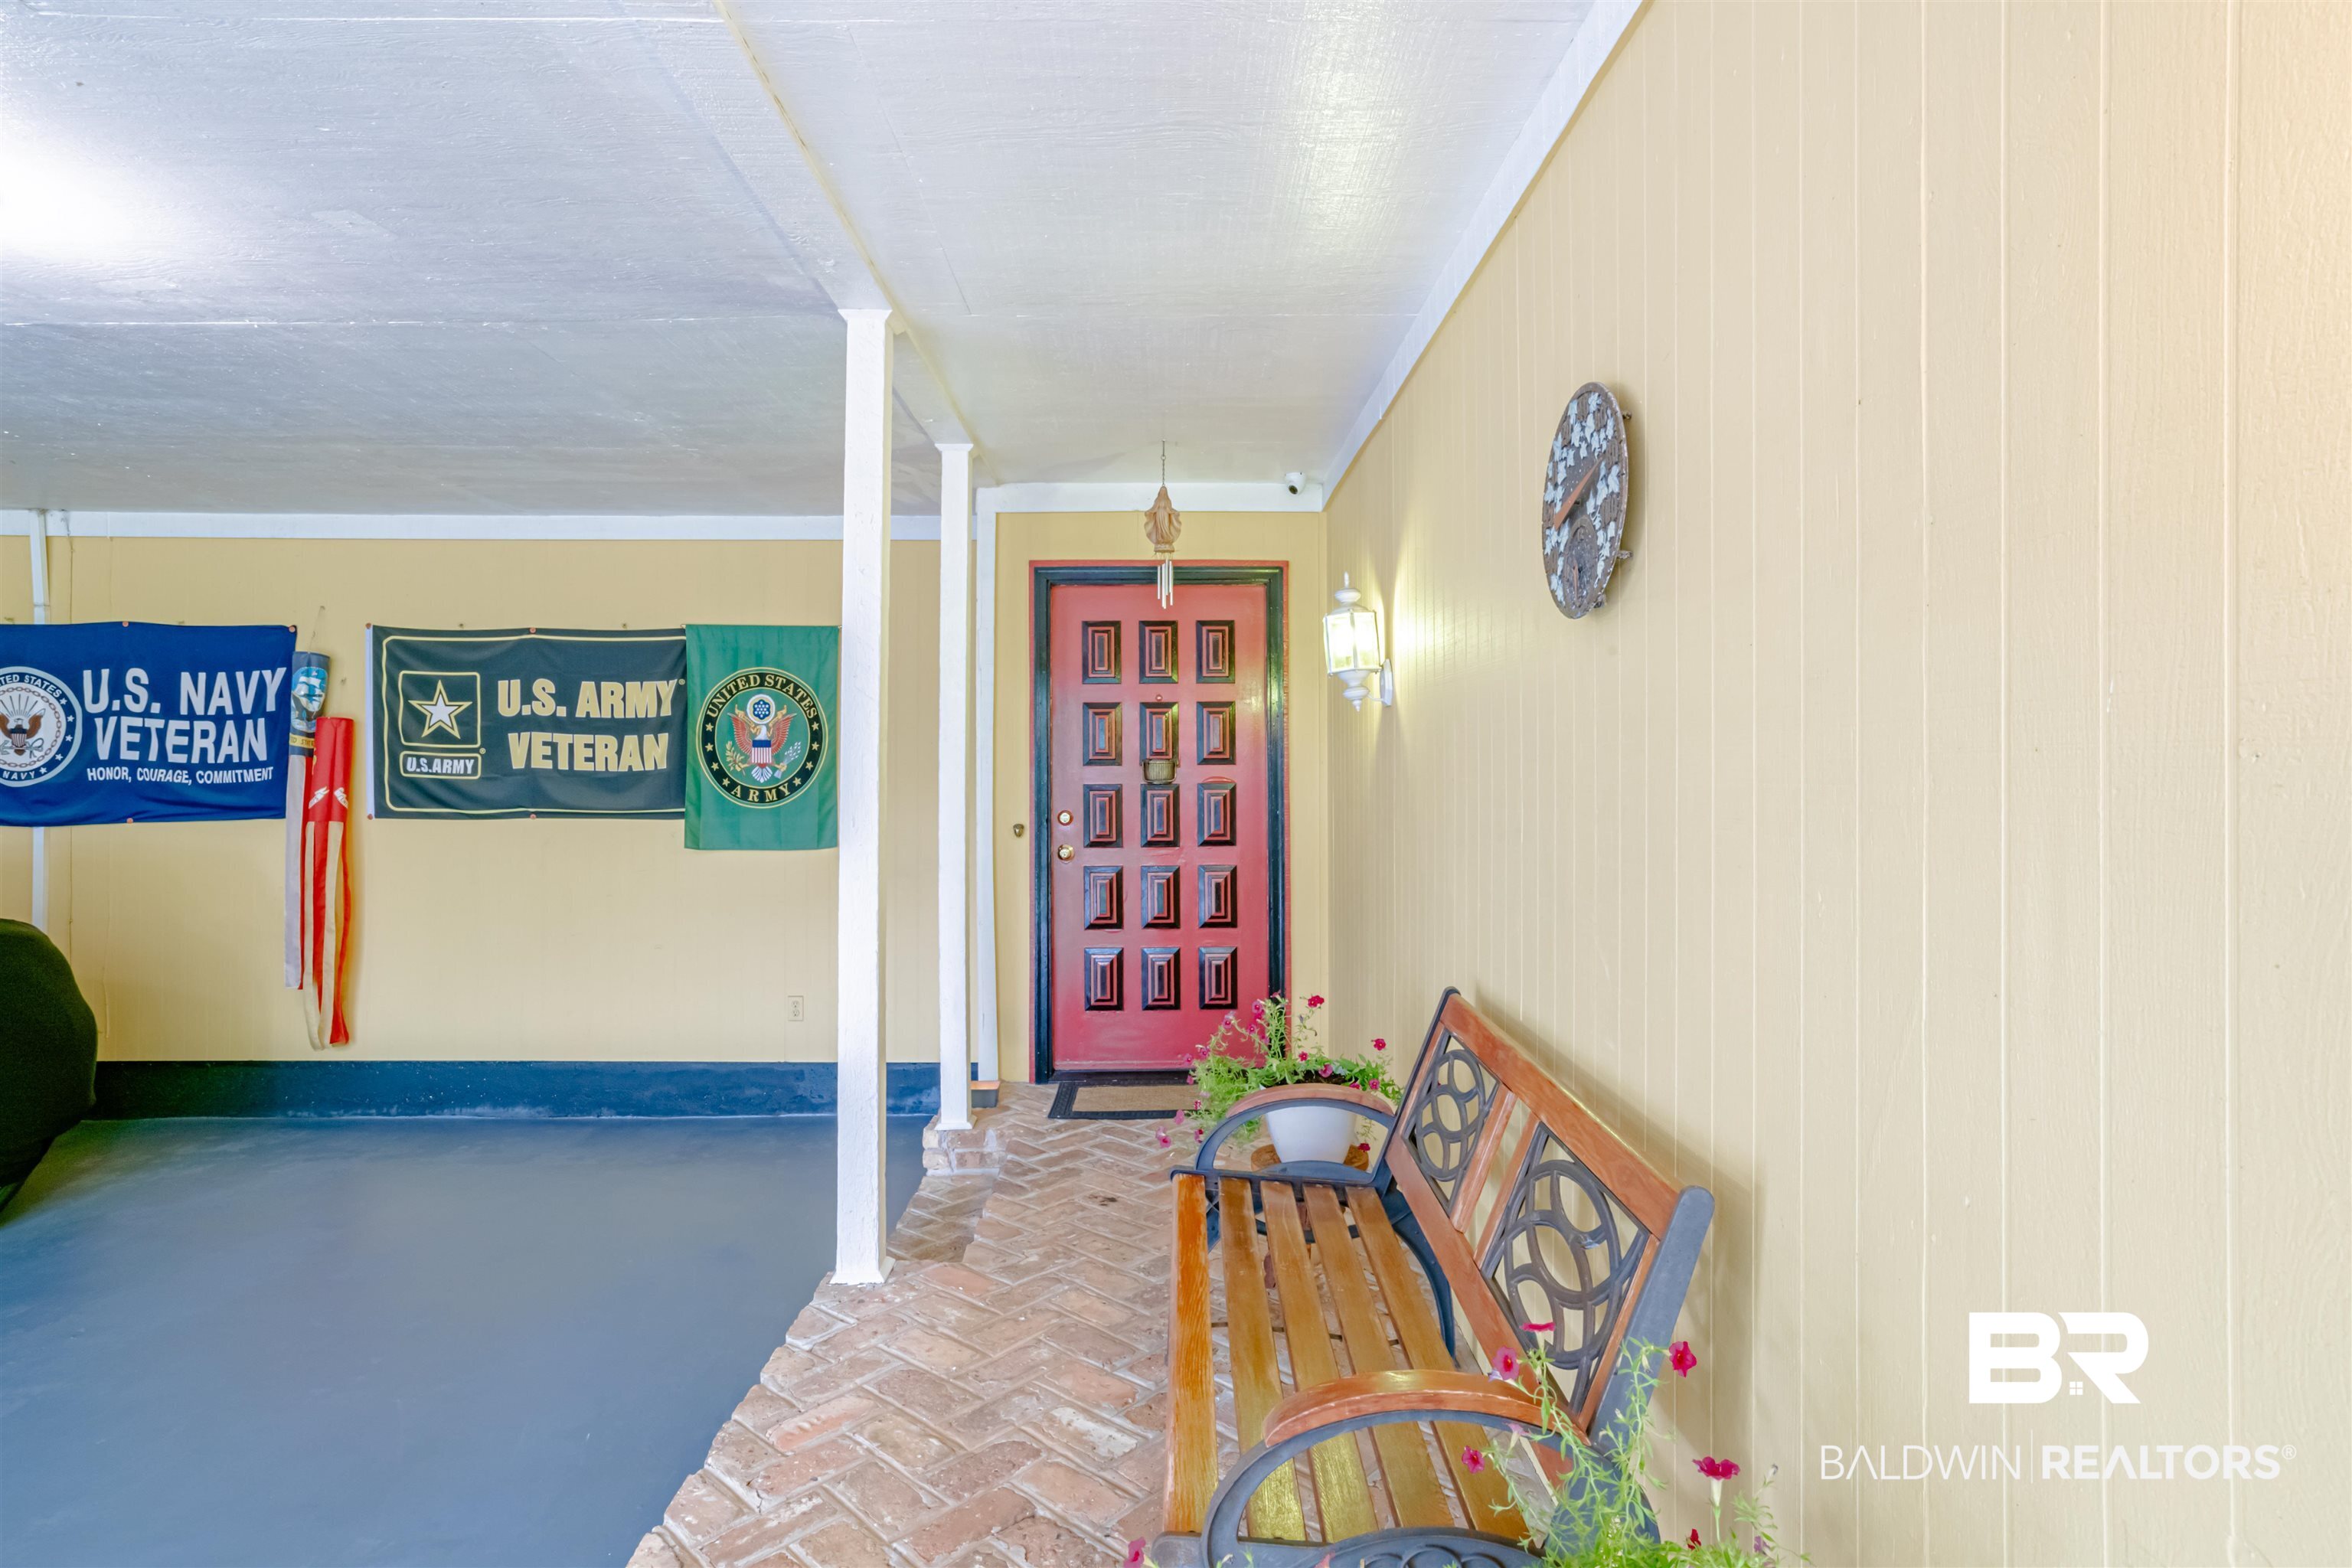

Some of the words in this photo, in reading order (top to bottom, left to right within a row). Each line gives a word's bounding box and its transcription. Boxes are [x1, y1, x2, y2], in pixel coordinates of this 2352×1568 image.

[0, 674, 20, 685] TED
[24, 675, 63, 697] STATES
[83, 668, 161, 714] U.S.
[180, 668, 287, 716] NAVY
[498, 678, 567, 717] U.S.
[707, 675, 760, 718] UNITED
[764, 675, 818, 719] STATES
[94, 716, 268, 764] VETERAN
[508, 731, 669, 772] VETERAN
[2, 770, 35, 780] NAVY
[87, 766, 132, 783] HONOR,
[136, 767, 192, 786] COURAGE,
[196, 766, 274, 784] COMMITMENT
[406, 756, 475, 774] U.S.ARMY
[732, 783, 791, 802] ARMY
